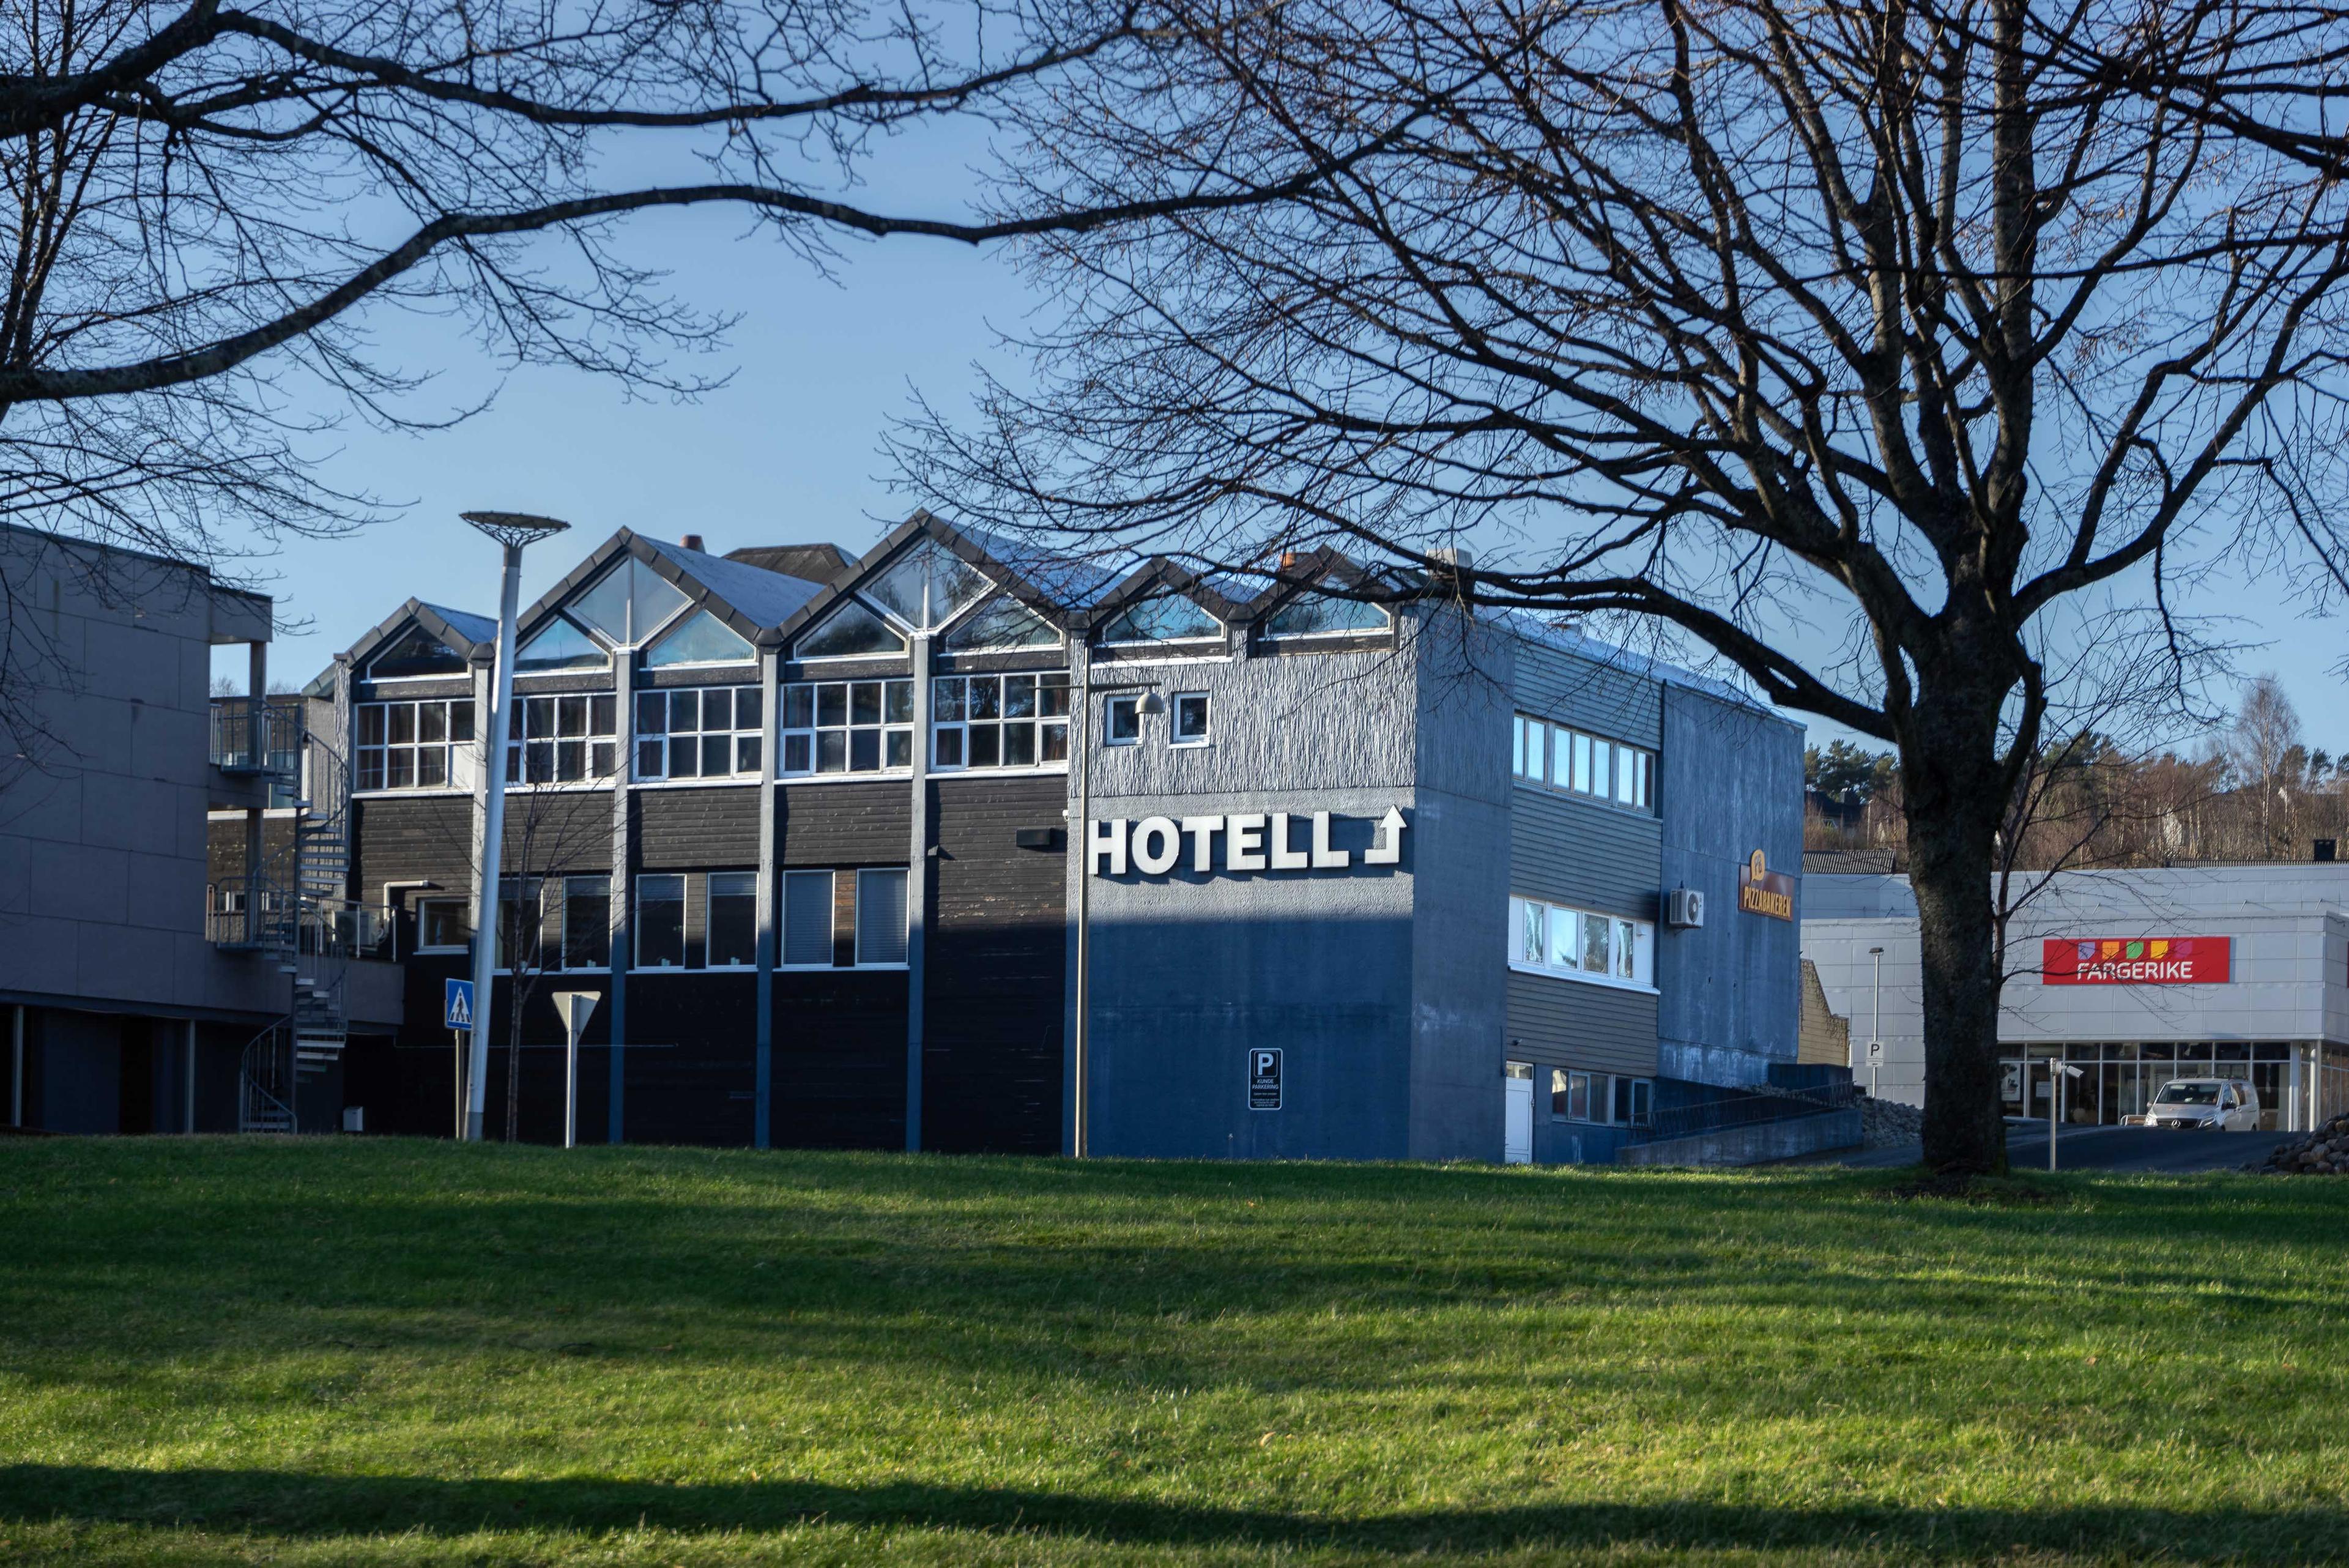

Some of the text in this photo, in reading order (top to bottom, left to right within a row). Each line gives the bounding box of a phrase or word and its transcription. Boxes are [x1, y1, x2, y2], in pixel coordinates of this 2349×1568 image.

[1088, 811, 1349, 875] HOTELL
[1744, 886, 1792, 917] PIZZABAKEREN
[2077, 961, 2193, 980] FARGERIKE
[1871, 1044, 1880, 1056] P
[1258, 1053, 1274, 1075] P
